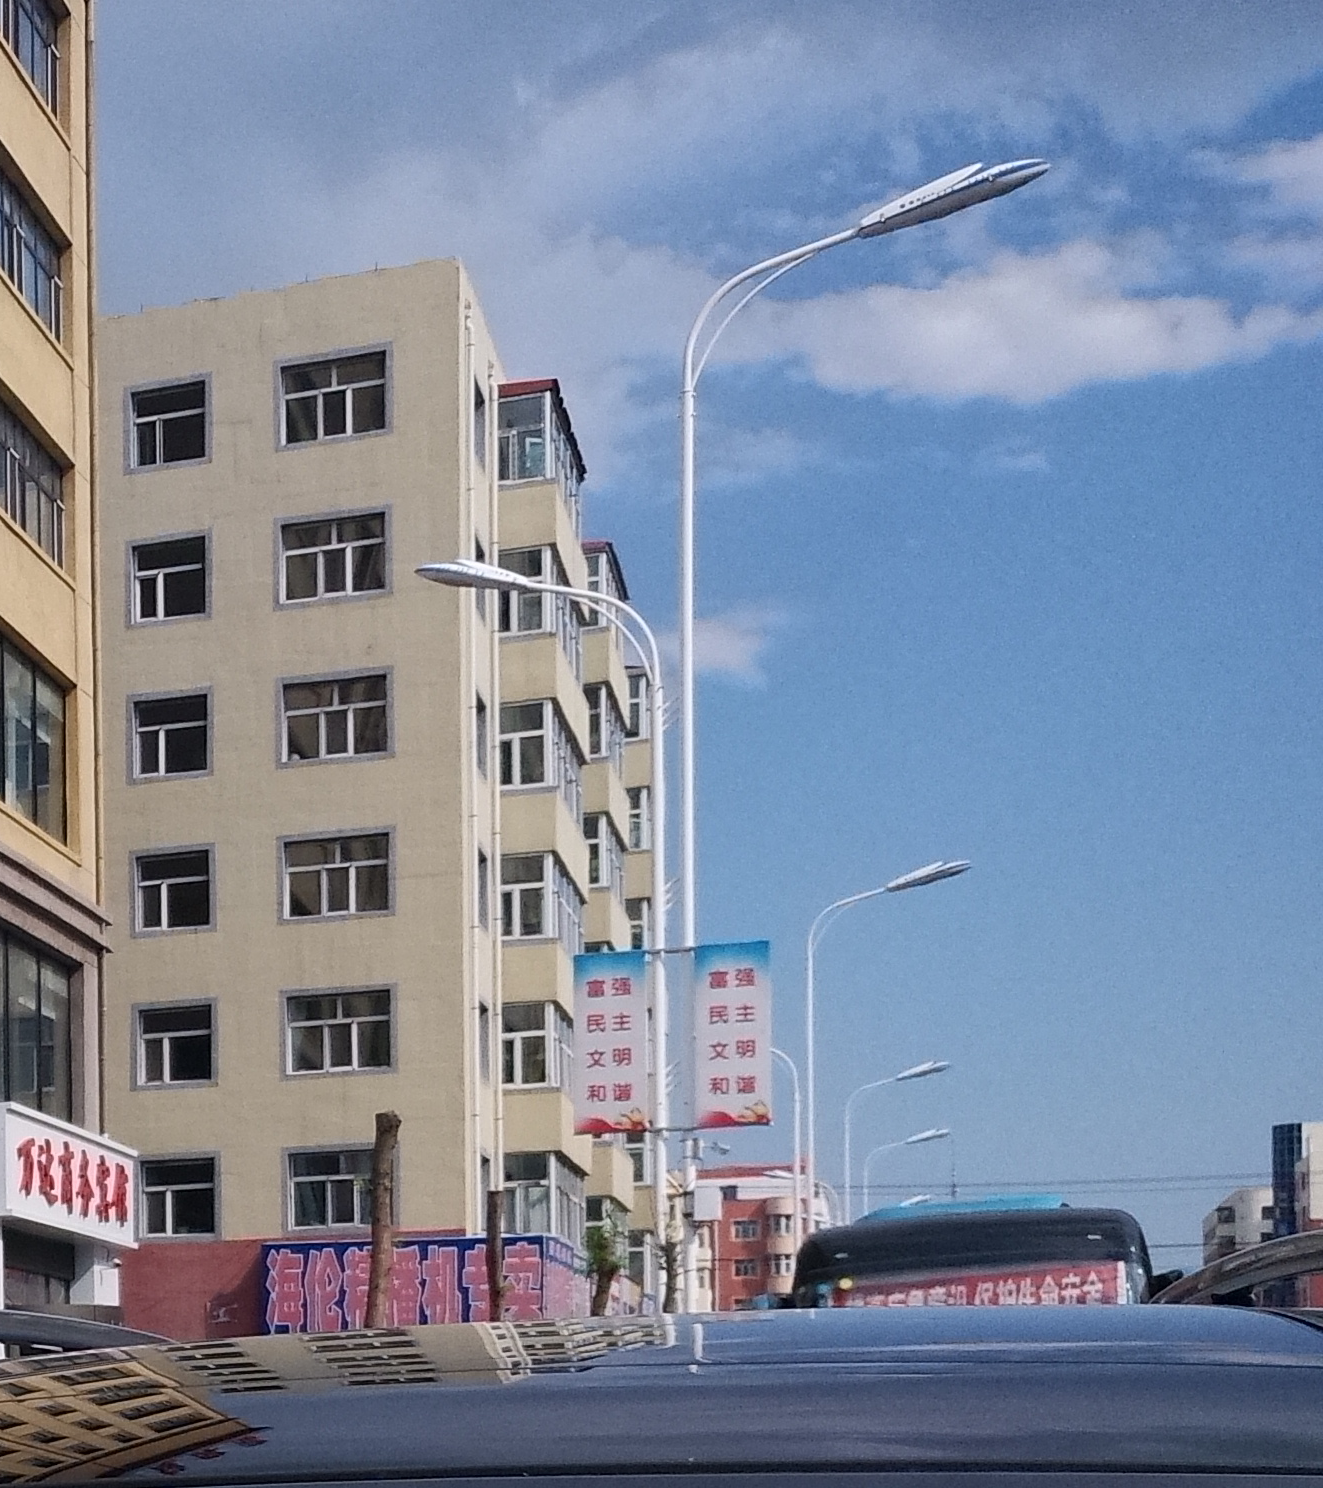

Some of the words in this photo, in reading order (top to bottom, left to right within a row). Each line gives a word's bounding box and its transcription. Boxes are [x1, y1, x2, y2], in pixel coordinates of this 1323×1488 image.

[586, 977, 631, 998] 富强
[708, 968, 755, 989] 富强
[586, 1012, 631, 1033] 民主
[708, 1005, 755, 1025] 民主
[586, 1048, 632, 1069] 文明
[708, 1040, 756, 1060] 文明
[586, 1083, 632, 1102] 和谐
[708, 1076, 756, 1095] 和谐
